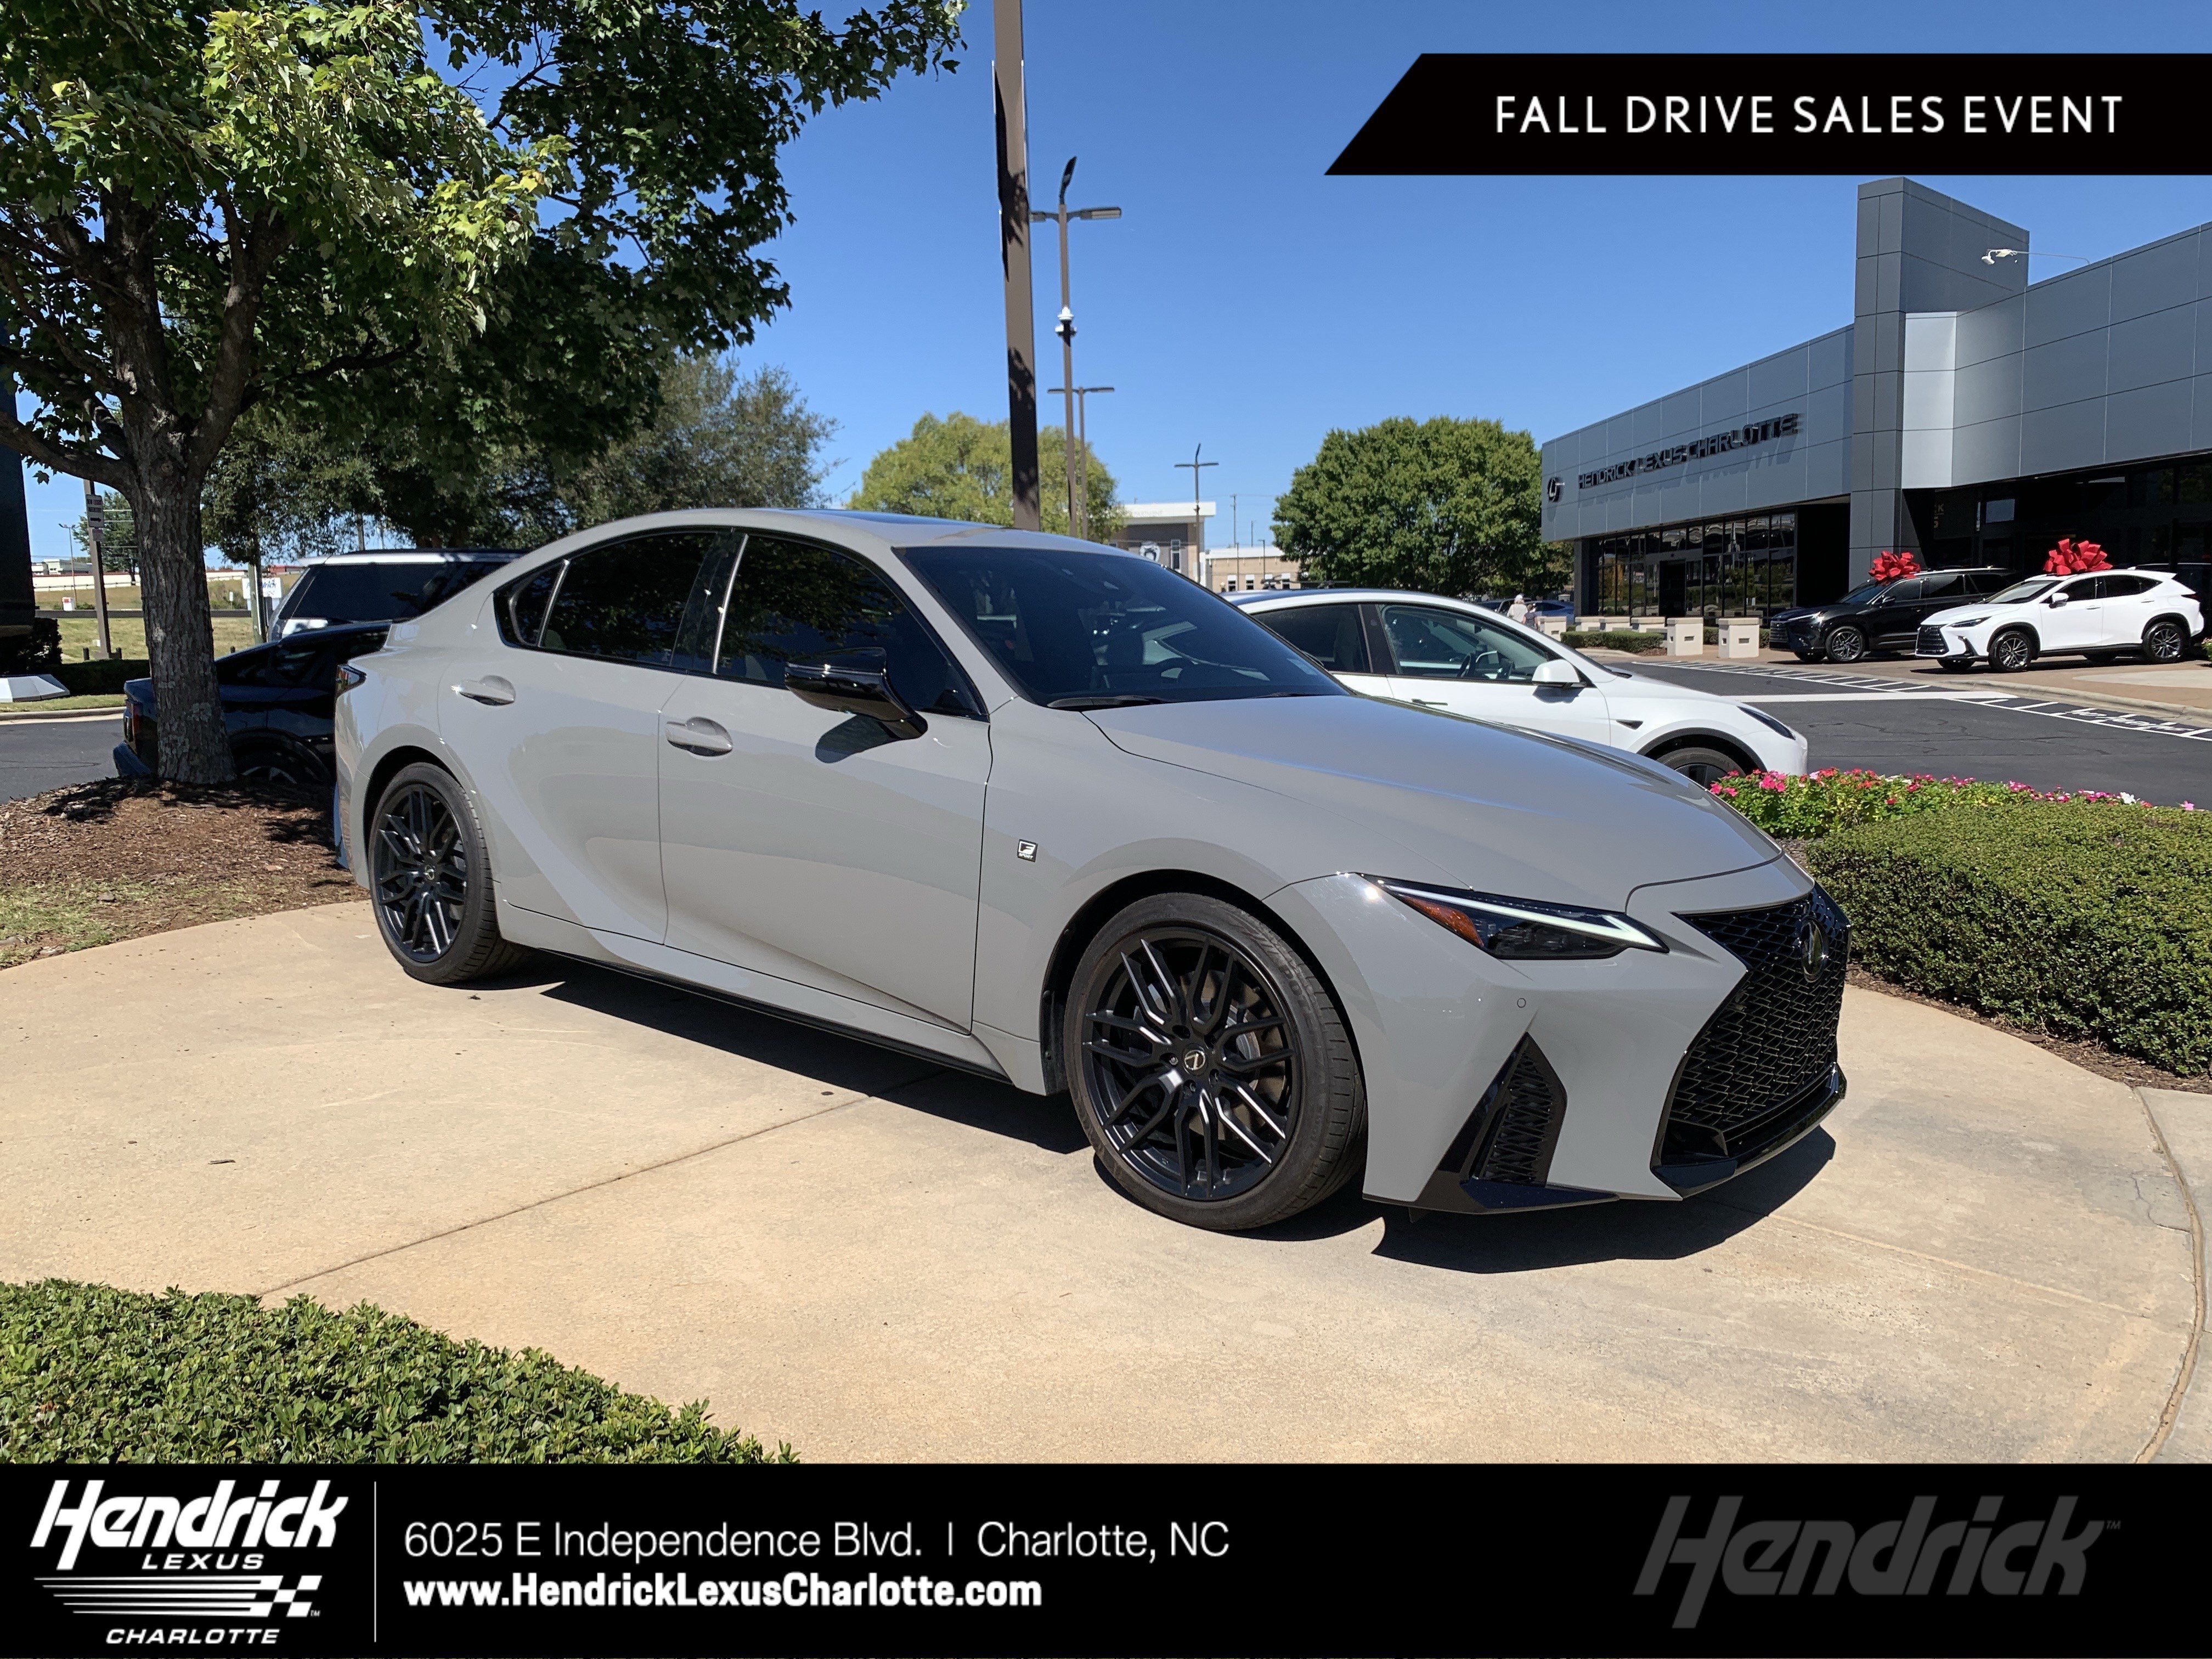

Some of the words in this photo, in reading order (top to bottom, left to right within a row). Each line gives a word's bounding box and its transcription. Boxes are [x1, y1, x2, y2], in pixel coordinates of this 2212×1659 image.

[1578, 459, 1637, 489] HENDRICK
[1636, 444, 1688, 475] LEXUS
[1688, 413, 1799, 460] CHARLOTTE
